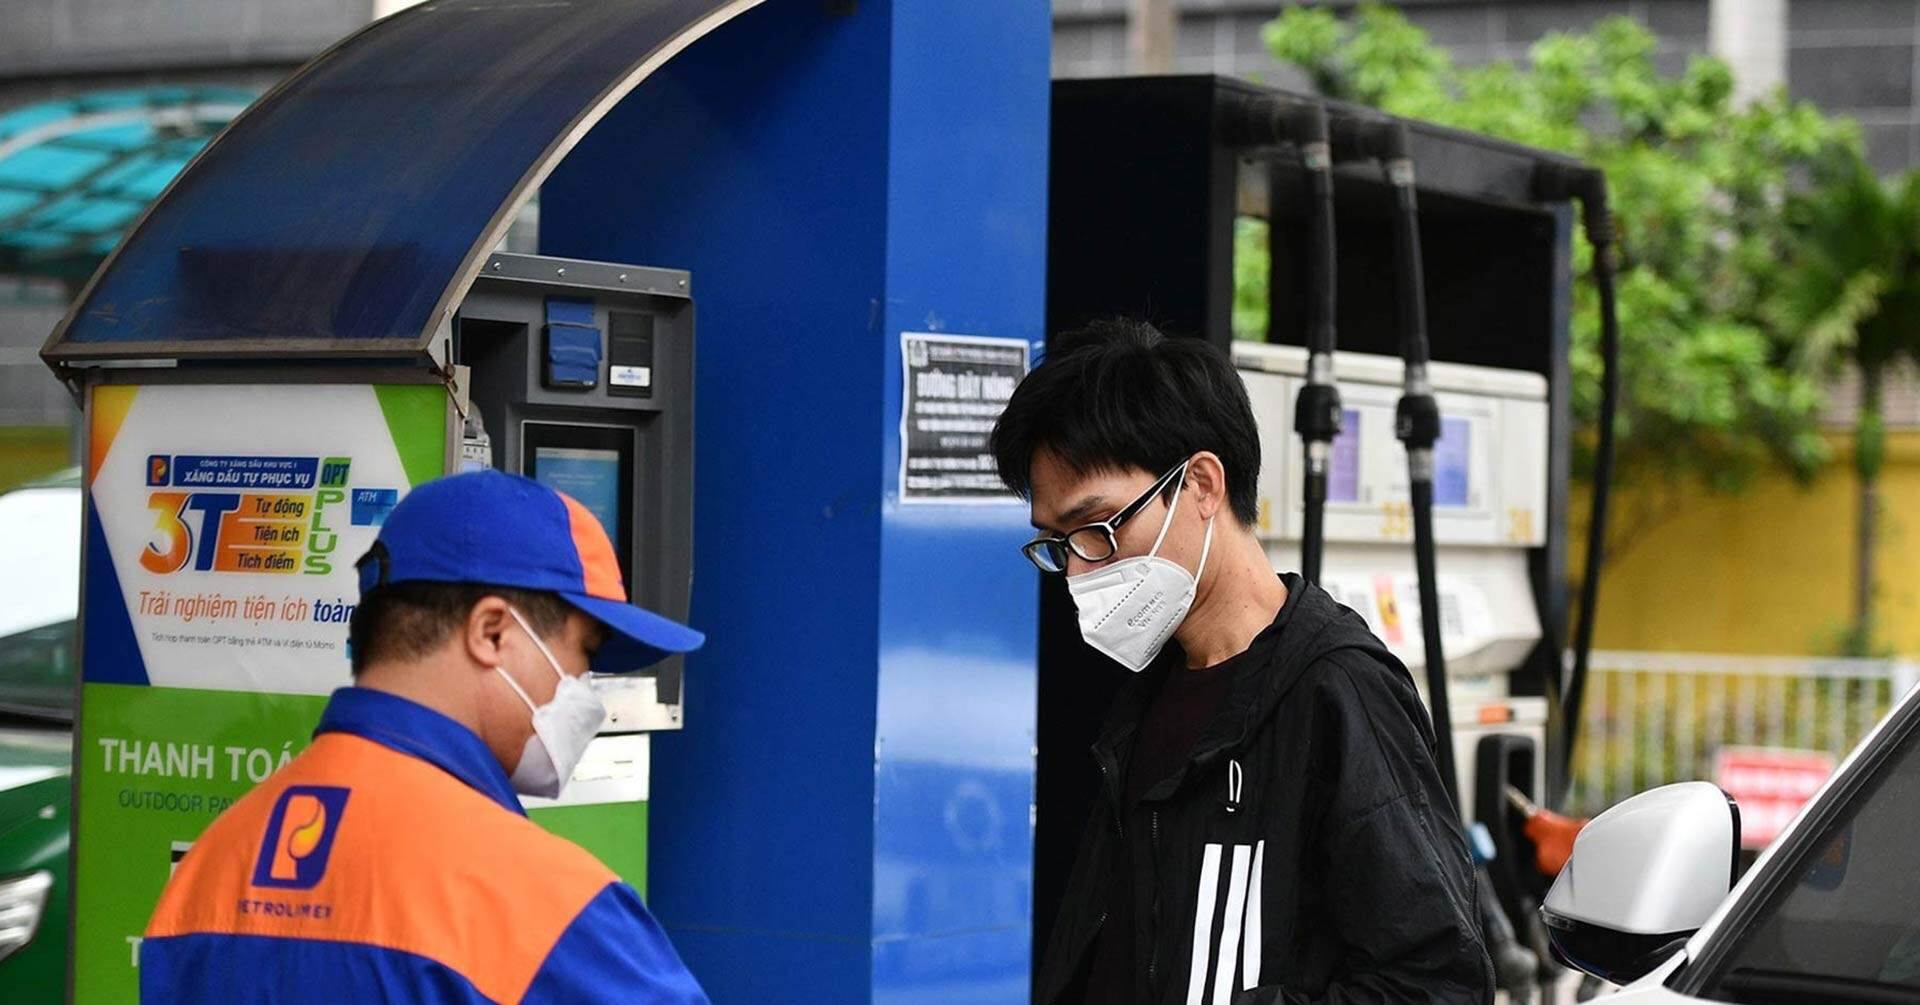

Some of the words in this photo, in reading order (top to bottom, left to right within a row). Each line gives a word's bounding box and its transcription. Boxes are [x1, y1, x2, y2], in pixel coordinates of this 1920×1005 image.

[242, 472, 259, 487] TỰ
[260, 472, 292, 487] PHỤC
[295, 473, 311, 488] VỤ
[321, 464, 351, 486] OPT
[357, 491, 378, 503] ATM
[255, 498, 272, 518] Tự
[274, 498, 304, 518] động
[254, 525, 278, 546] Tiện
[281, 526, 300, 542] ích
[303, 490, 346, 575] PLUS
[264, 552, 295, 570] điểm
[140, 591, 171, 616] Trải
[174, 593, 238, 624] nghiệm
[243, 595, 276, 626] tiện
[281, 596, 308, 621] ích
[99, 738, 214, 780] THANH
[119, 789, 202, 812] OUTDOOR
